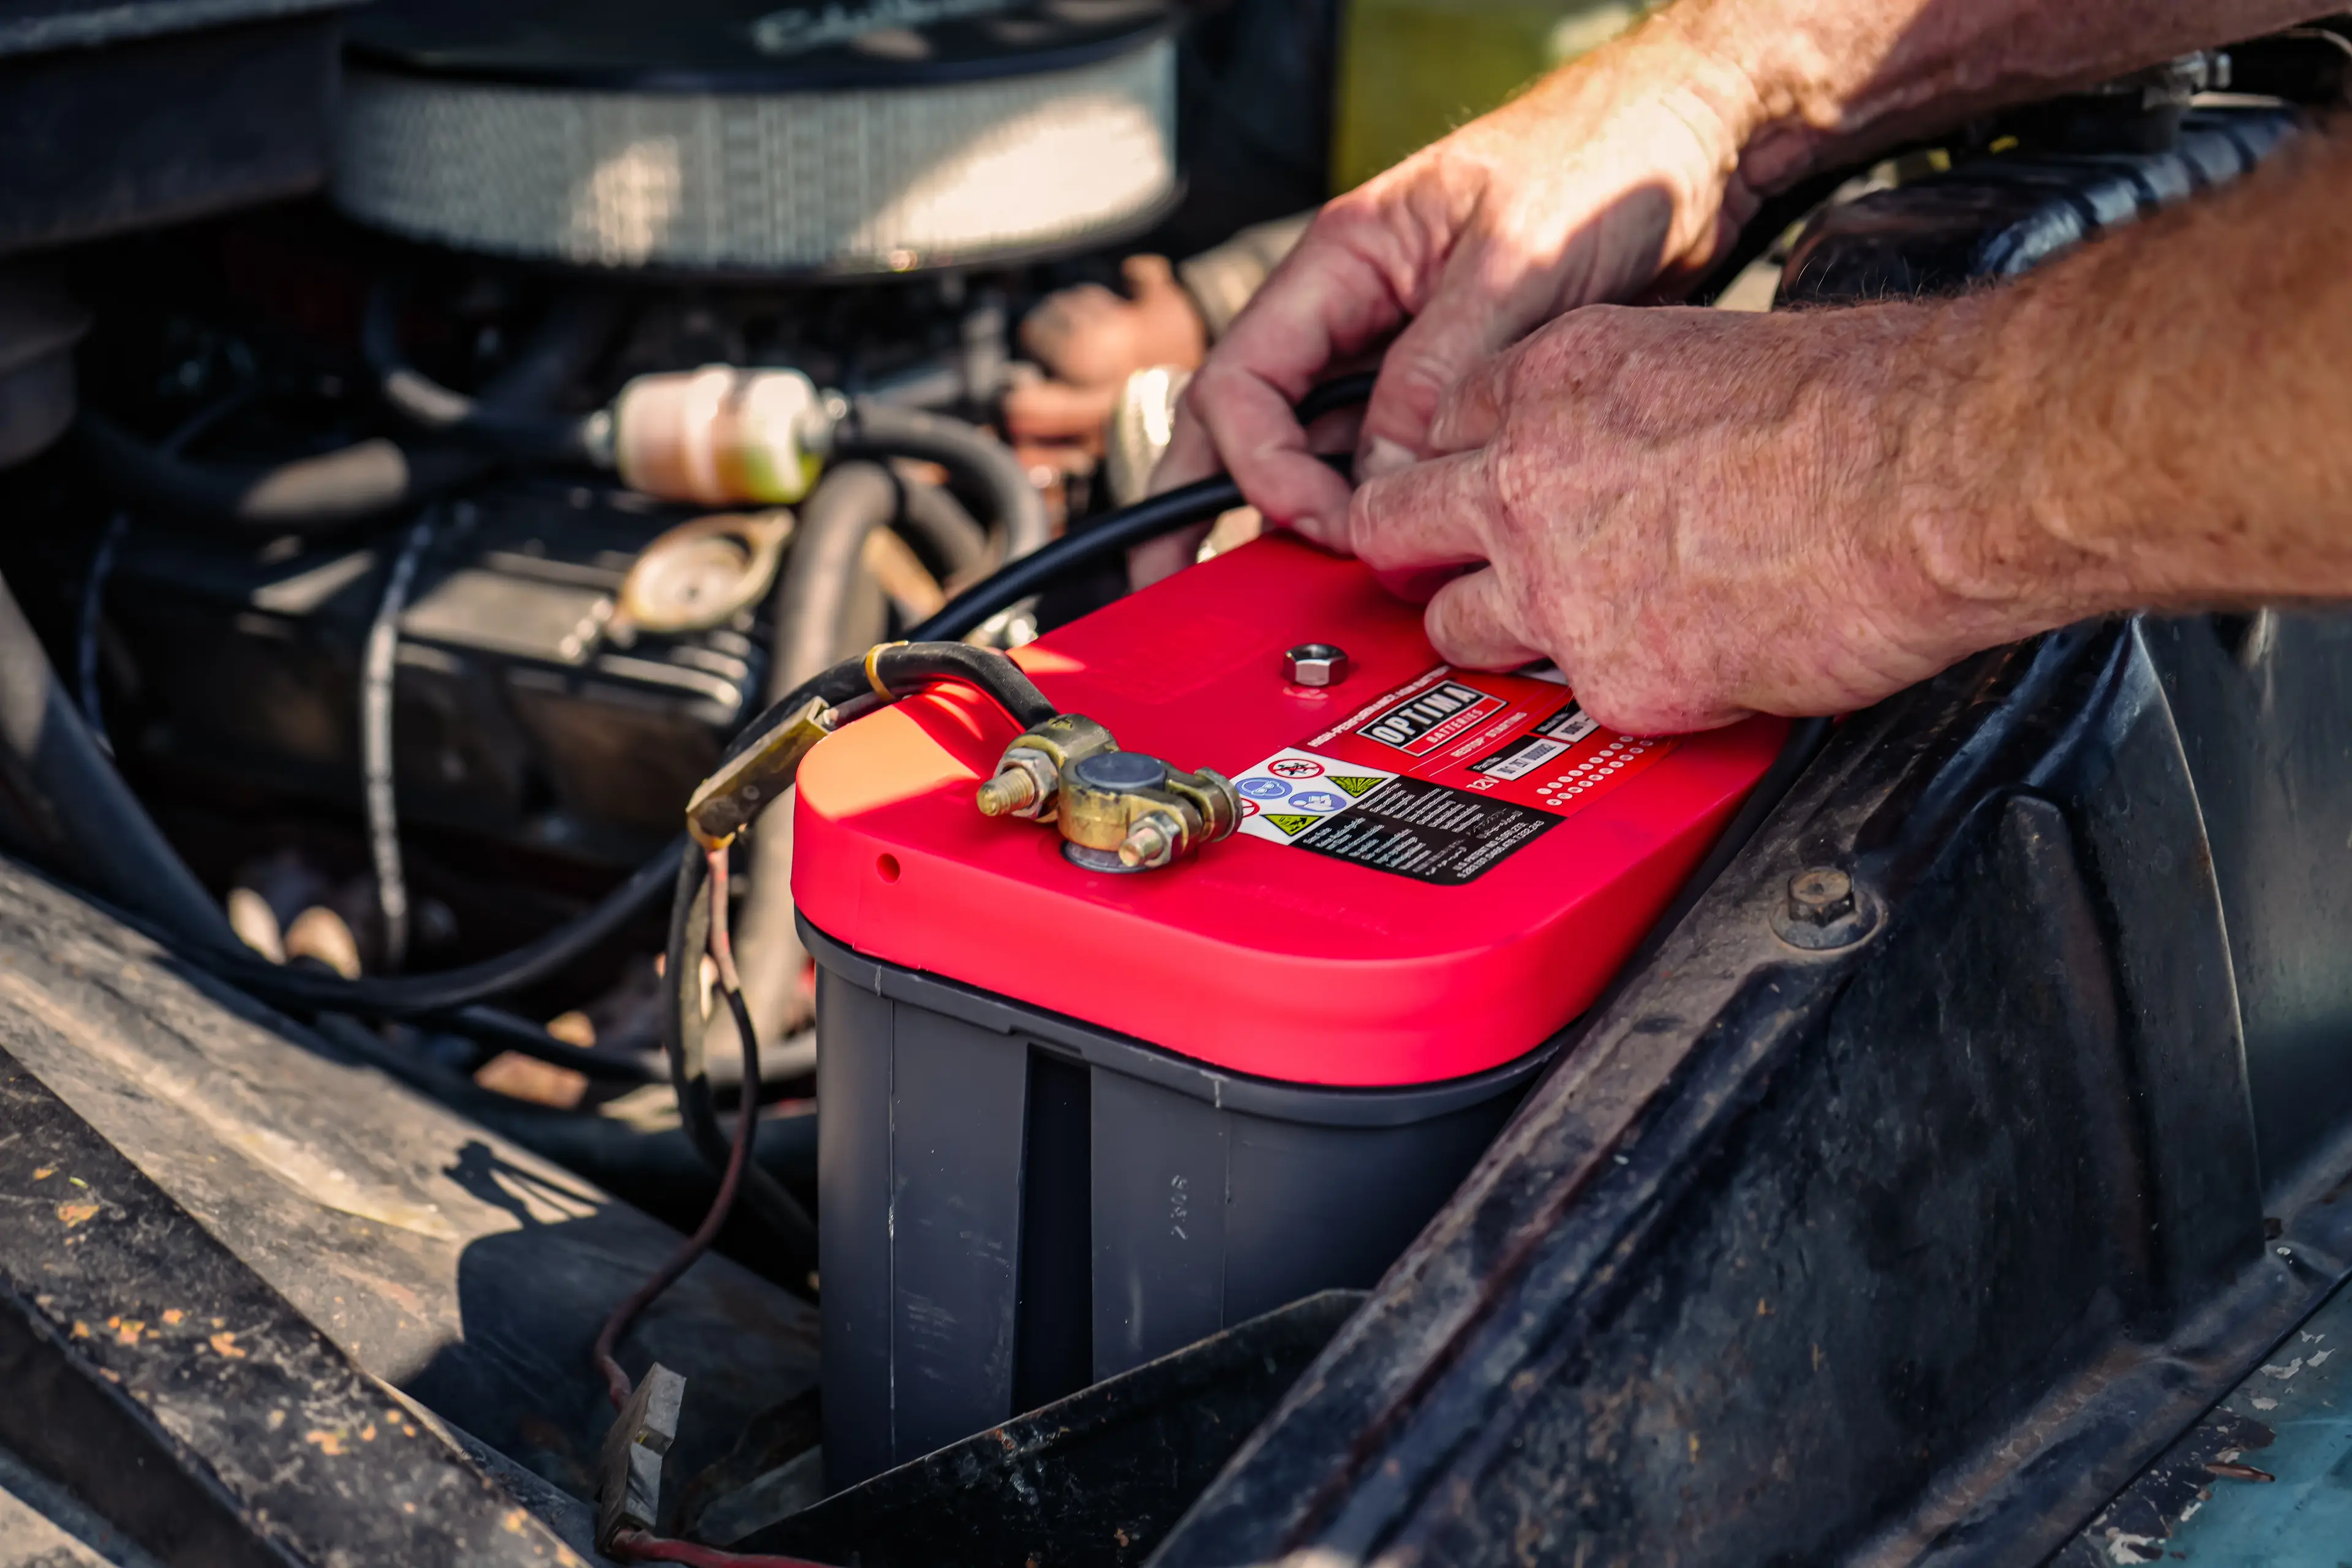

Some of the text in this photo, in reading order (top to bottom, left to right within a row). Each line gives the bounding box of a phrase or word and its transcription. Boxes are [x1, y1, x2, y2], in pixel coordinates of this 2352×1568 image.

[1372, 687, 1477, 744] OPTIMA
[1426, 709, 1483, 744] BATTERIES
[1485, 712, 1528, 737] STARTING
[1466, 775, 1500, 790] 12V
